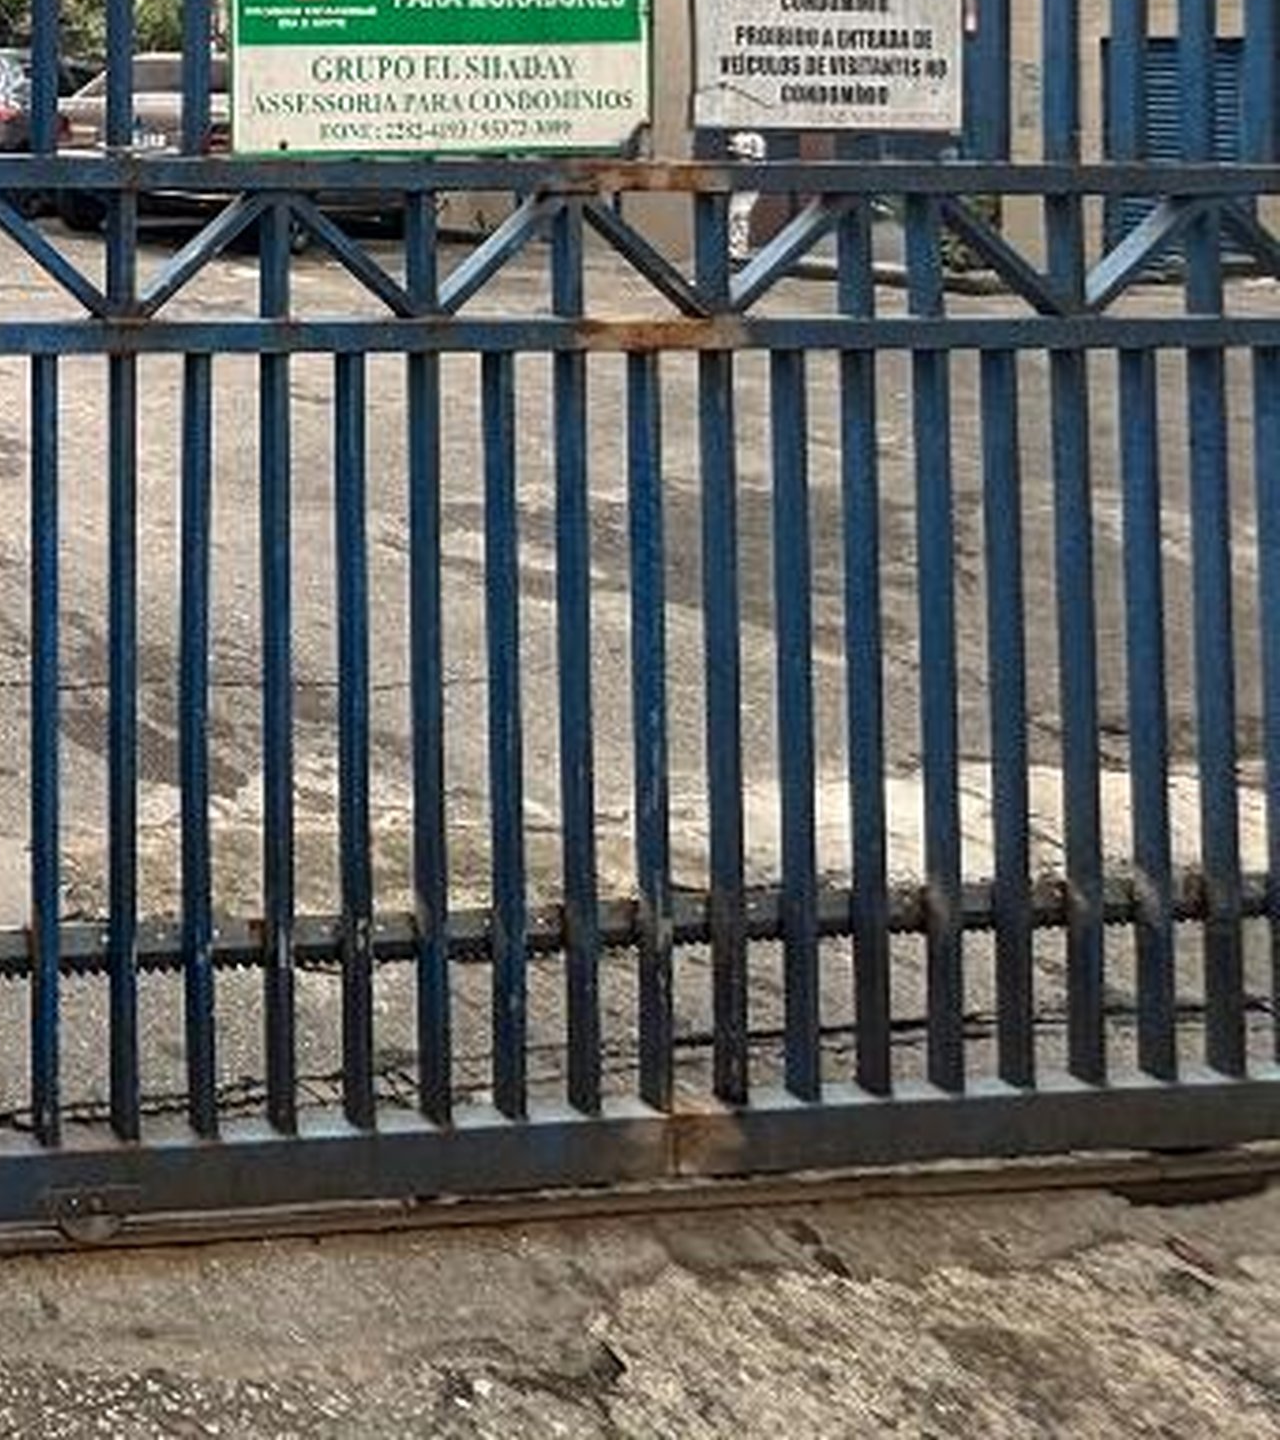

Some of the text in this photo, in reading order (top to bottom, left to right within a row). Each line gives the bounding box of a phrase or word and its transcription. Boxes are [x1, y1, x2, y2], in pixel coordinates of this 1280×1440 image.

[822, 28, 835, 48] A
[311, 55, 416, 83] GRUPO
[464, 54, 577, 80] SHADAY
[804, 55, 827, 76] DE
[253, 92, 397, 114] ASSESSORIA
[402, 90, 463, 113] PARA
